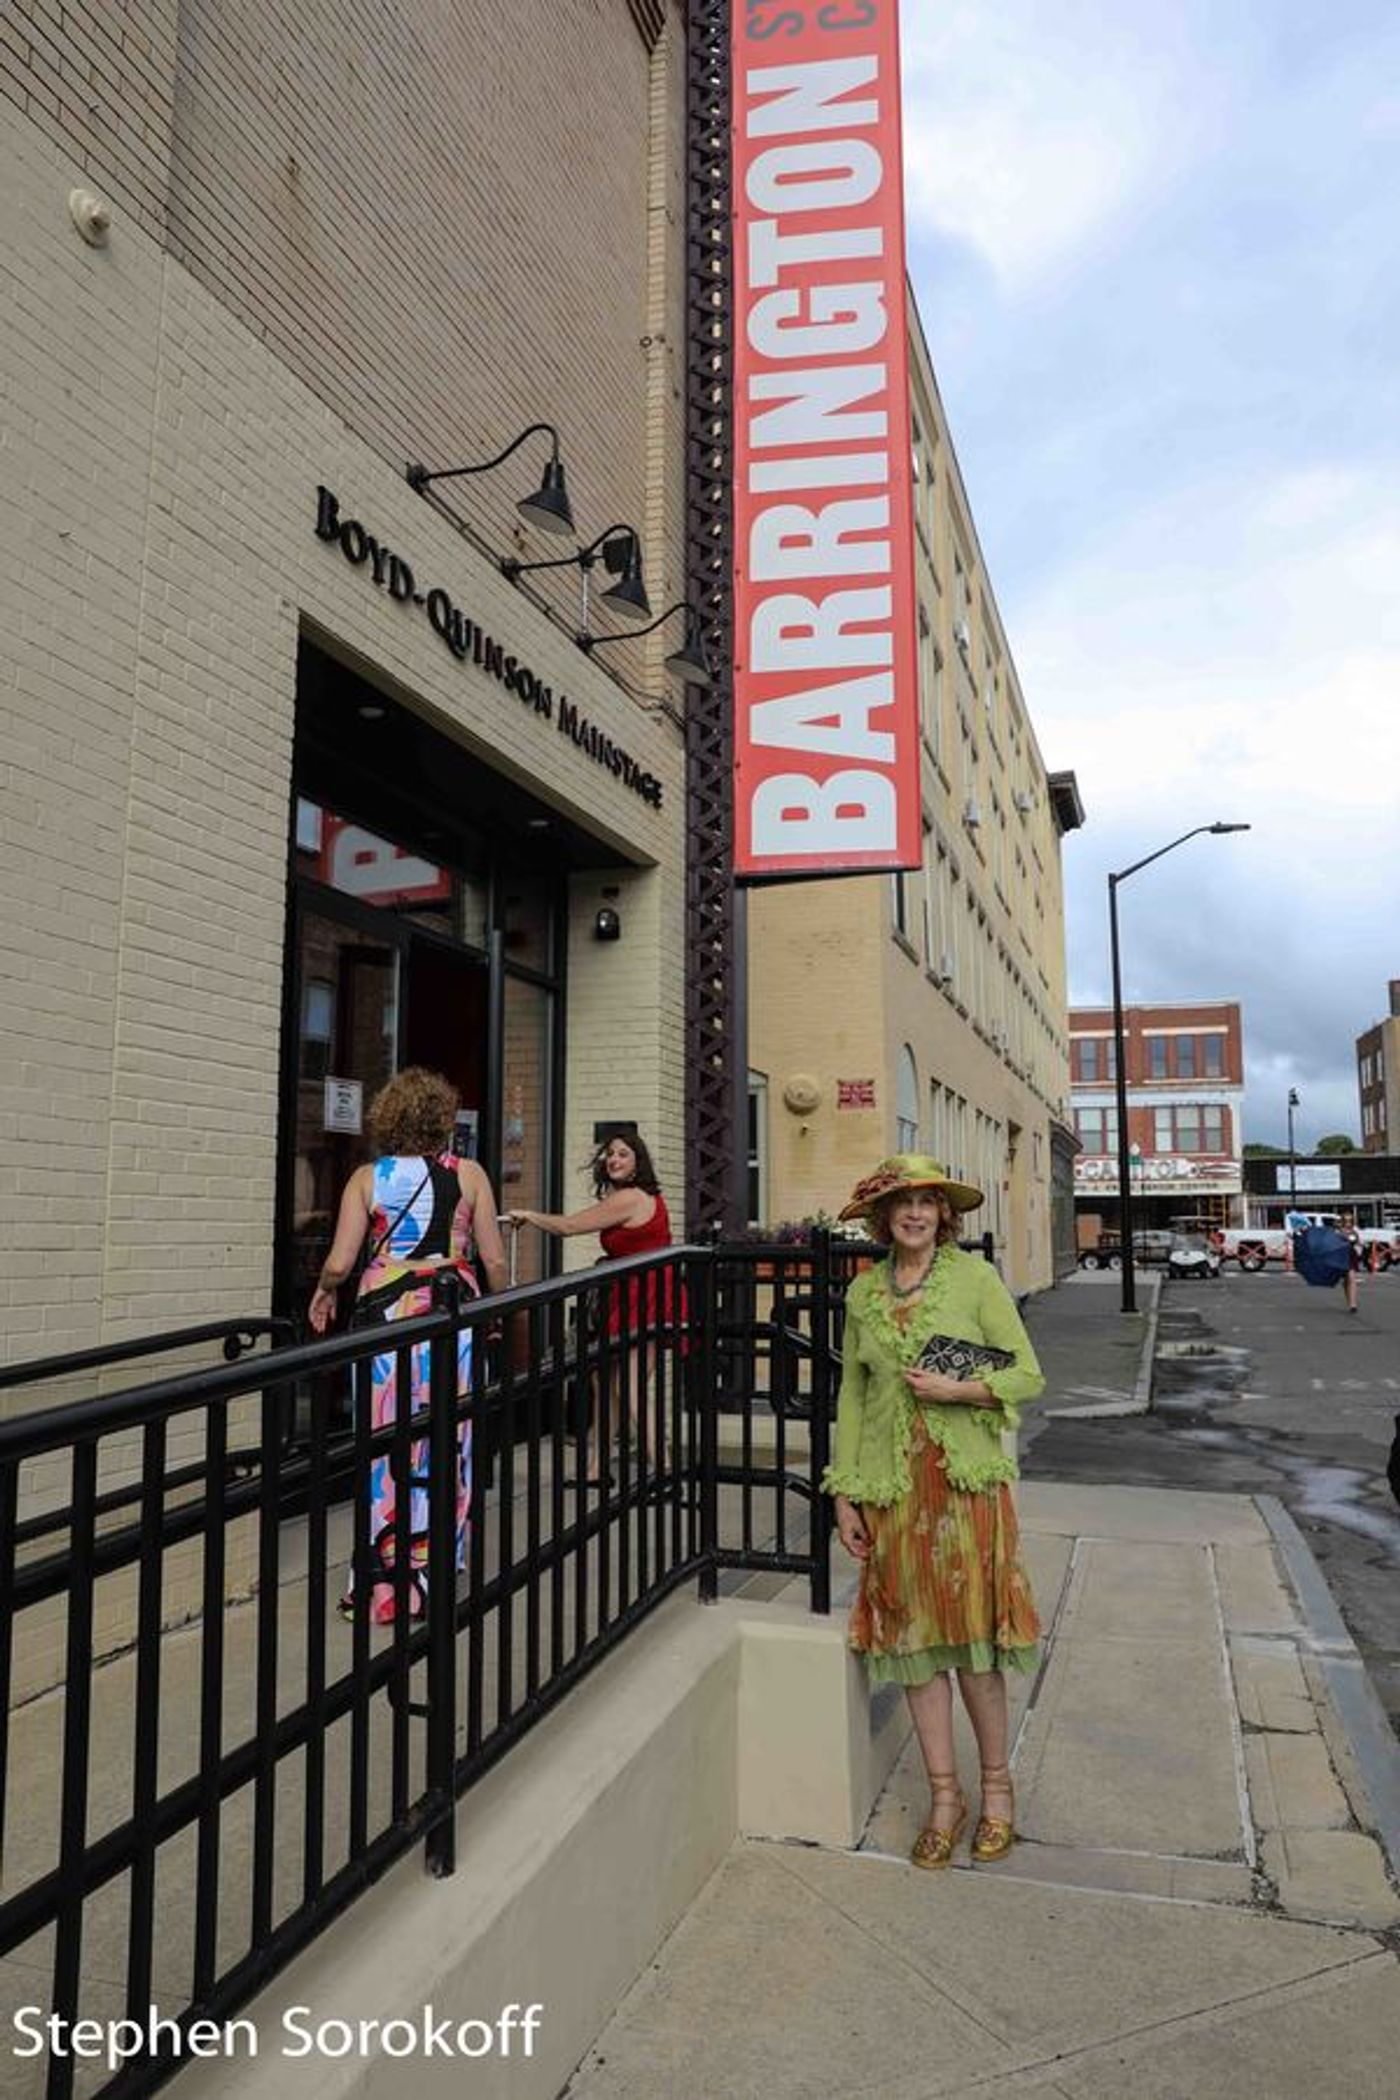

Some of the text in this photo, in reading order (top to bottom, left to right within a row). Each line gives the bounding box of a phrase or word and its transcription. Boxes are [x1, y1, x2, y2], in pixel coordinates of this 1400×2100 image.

[314, 484, 662, 810] BOYD-QUINSON MAINSTAGE
[746, 54, 897, 856] BARRINGTON
